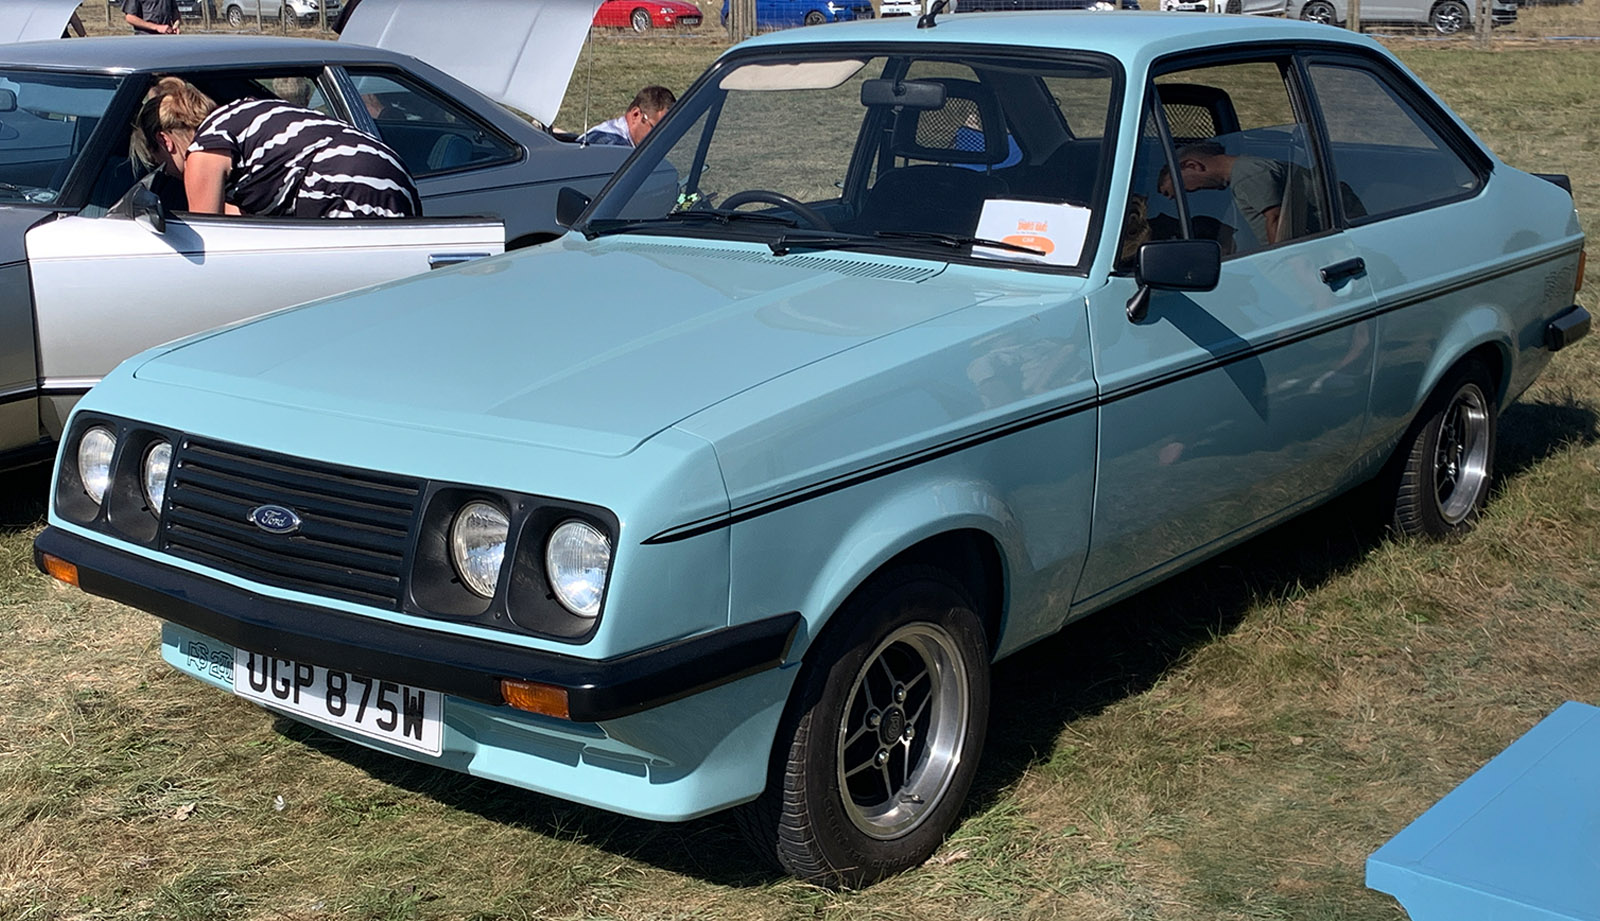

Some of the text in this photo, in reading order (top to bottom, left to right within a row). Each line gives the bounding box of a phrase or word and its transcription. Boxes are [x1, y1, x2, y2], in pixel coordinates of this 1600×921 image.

[261, 510, 288, 527] Ford
[187, 641, 209, 671] RS
[248, 651, 425, 741] UGP 875W
